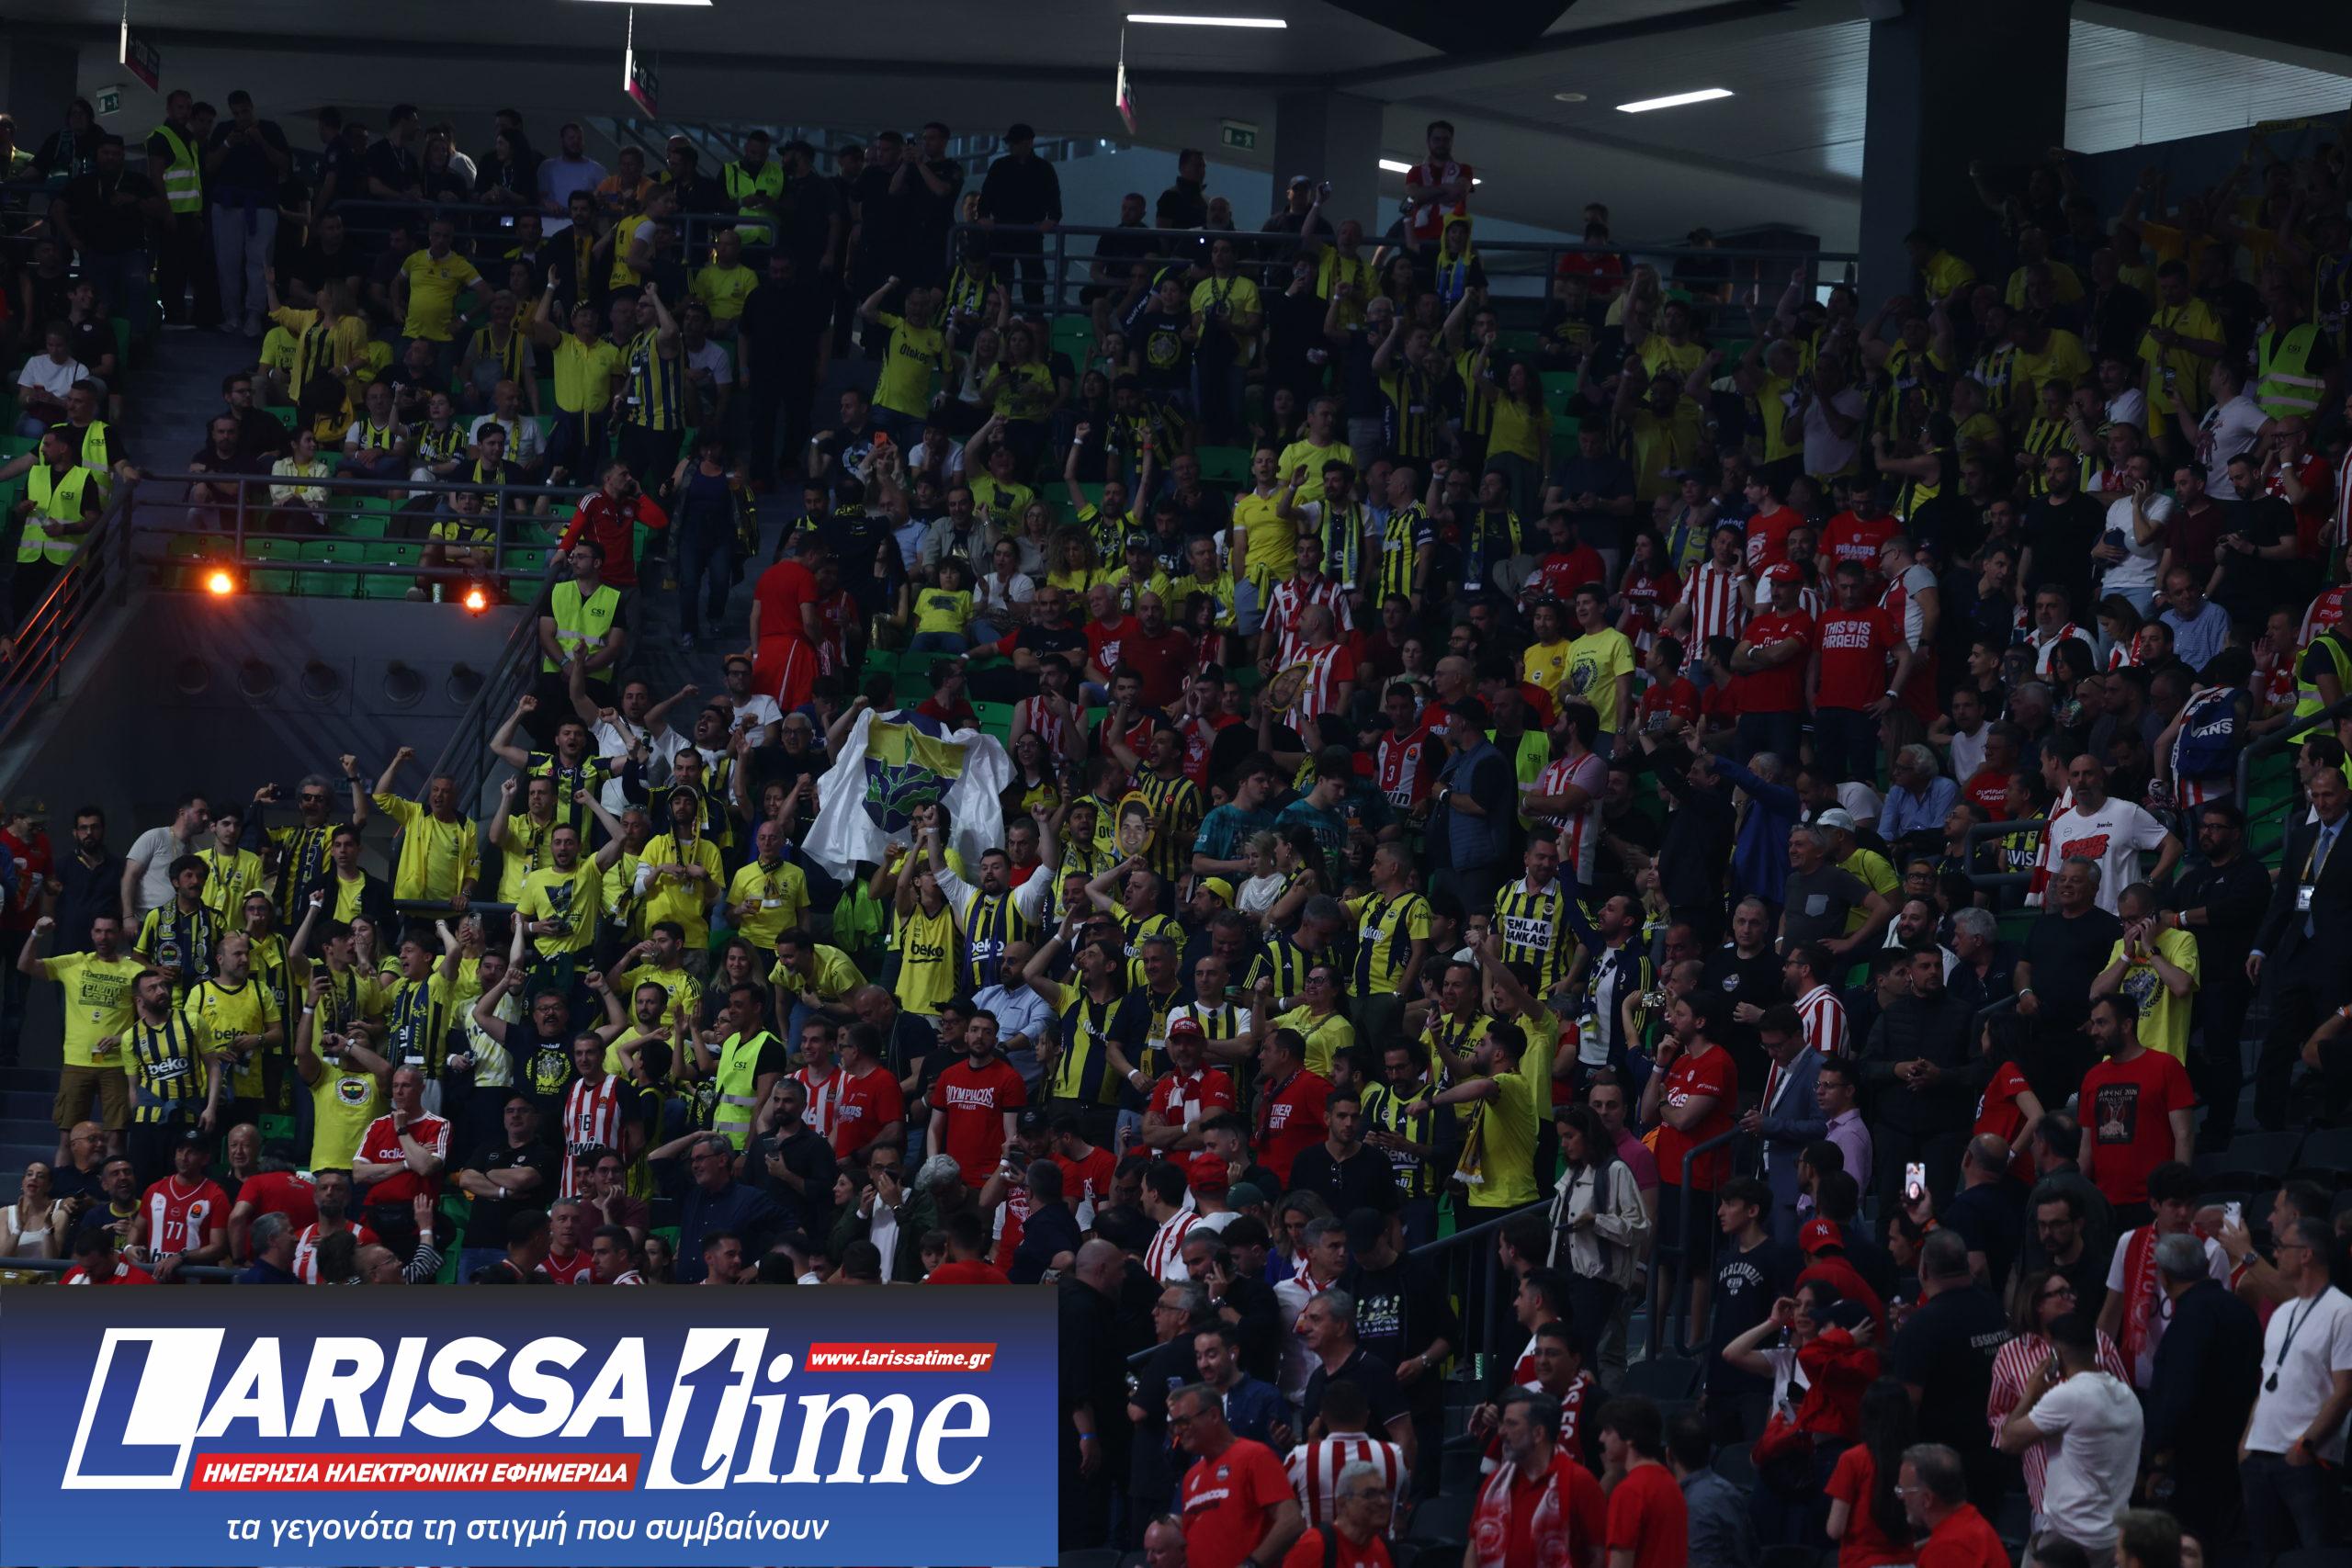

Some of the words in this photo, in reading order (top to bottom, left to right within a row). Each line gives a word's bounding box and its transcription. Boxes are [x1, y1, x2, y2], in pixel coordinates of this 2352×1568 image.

[1836, 544, 1876, 557] PIRAEUS
[1825, 621, 1847, 636] THIS
[1857, 620, 1871, 636] IS
[1822, 632, 1869, 649] PIRAEUS
[2190, 718, 2233, 739] VANS
[1386, 765, 1396, 782] 3
[1508, 919, 1546, 935] EMLAK
[910, 941, 944, 957] beko
[148, 1056, 189, 1077] beko
[946, 1085, 995, 1110] OLYMPIACOS
[1272, 1103, 1293, 1117] THER
[579, 1113, 591, 1133] 16
[166, 1220, 185, 1241] 77
